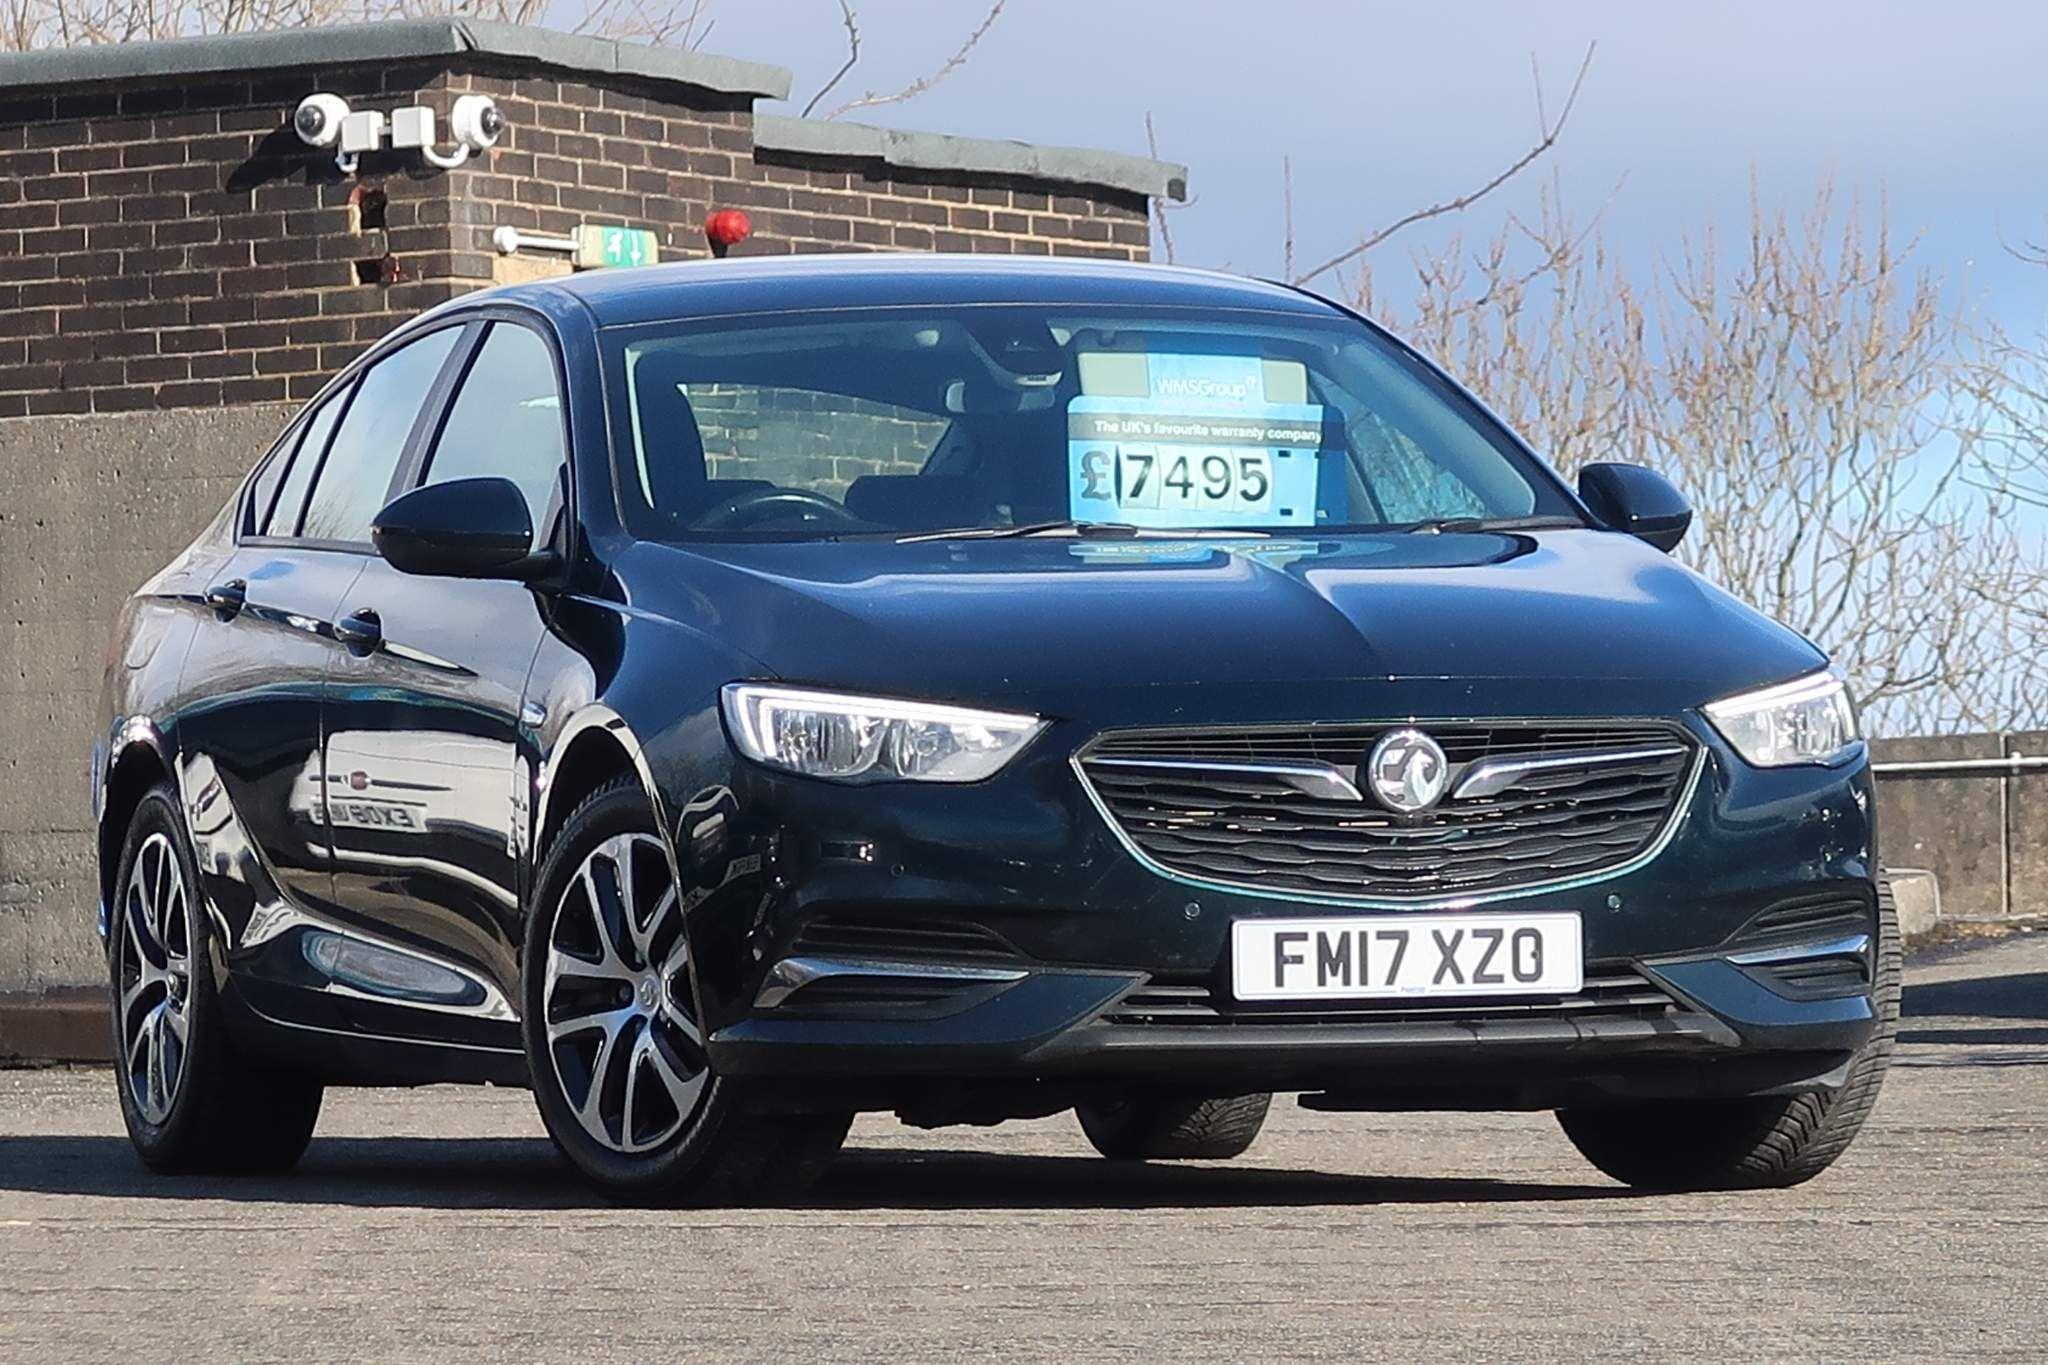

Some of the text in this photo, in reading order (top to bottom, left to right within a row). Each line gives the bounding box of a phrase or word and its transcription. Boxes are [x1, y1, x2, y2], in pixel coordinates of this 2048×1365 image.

[1156, 376, 1247, 399] WMSGroup
[1094, 420, 1321, 443] The UK's favourite warranty company
[1273, 927, 1544, 988] FM17 XZO
